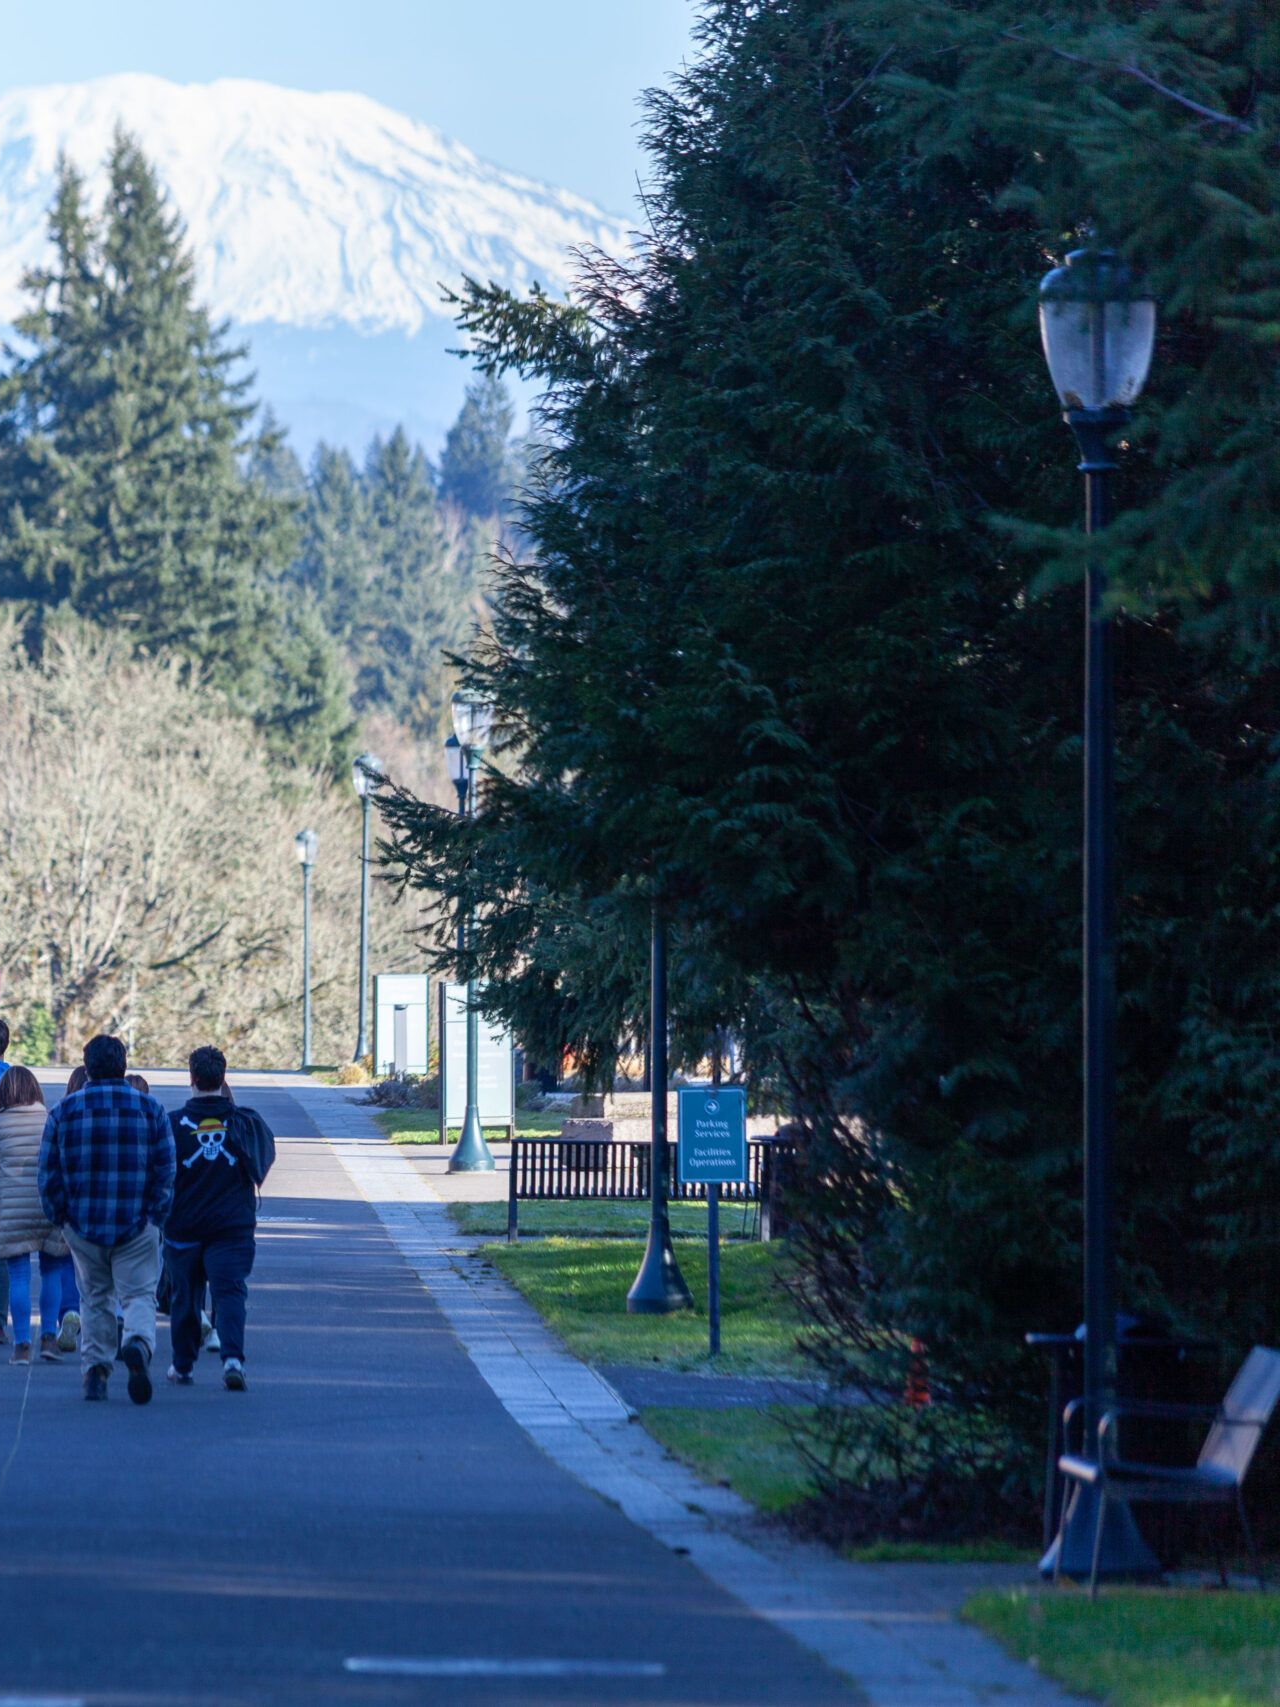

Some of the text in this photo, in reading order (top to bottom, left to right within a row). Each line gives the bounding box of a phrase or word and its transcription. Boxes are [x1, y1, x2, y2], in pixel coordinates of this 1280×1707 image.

[696, 1119, 728, 1129] Parking
[694, 1129, 730, 1138] Services
[694, 1147, 732, 1156] Facilities
[689, 1157, 736, 1168] Operations
